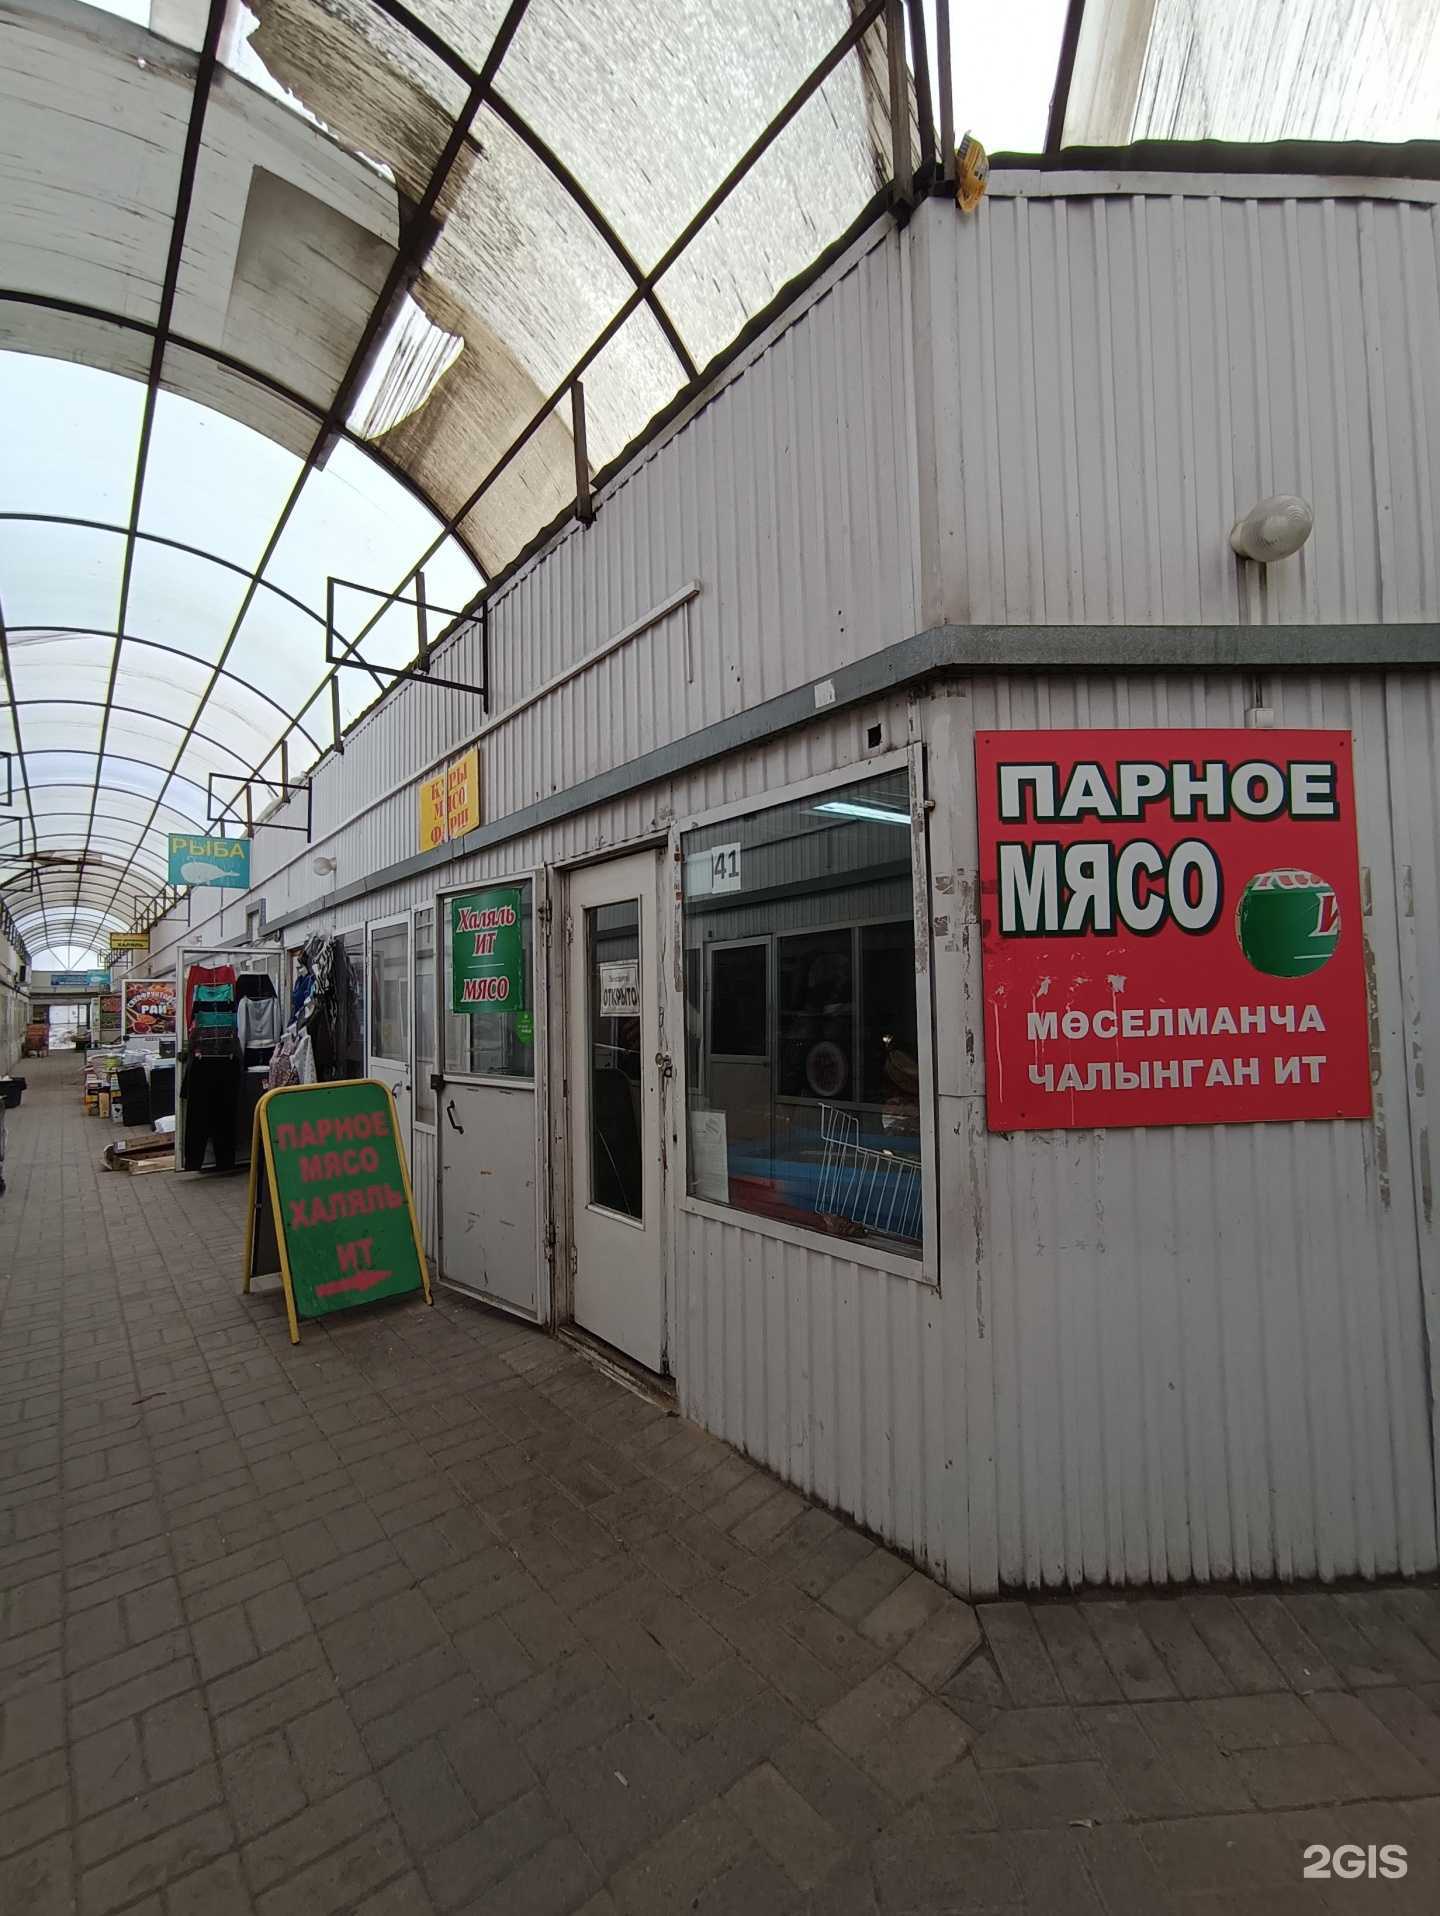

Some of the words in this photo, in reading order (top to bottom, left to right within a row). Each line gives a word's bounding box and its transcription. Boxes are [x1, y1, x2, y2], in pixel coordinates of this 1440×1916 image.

[997, 761, 1340, 822] ПАРНОЕ
[431, 808, 469, 844] ФРШ
[172, 837, 245, 859] РЫБА
[714, 850, 739, 880] 41
[997, 838, 1223, 936] МЯСО
[456, 904, 516, 933] Халяль
[472, 931, 497, 957] ИТ
[603, 986, 637, 1006] ОТКРЫТО
[1027, 1004, 1326, 1041] МӨСЕЛМАНЧА
[1028, 1058, 1261, 1092] ЧАЛЫНГАН
[1273, 1055, 1327, 1085] ИТ
[299, 1147, 379, 1182] МЯСО
[289, 1184, 404, 1231] ХАЛЯЛЬ
[336, 1238, 374, 1273] ИТ
